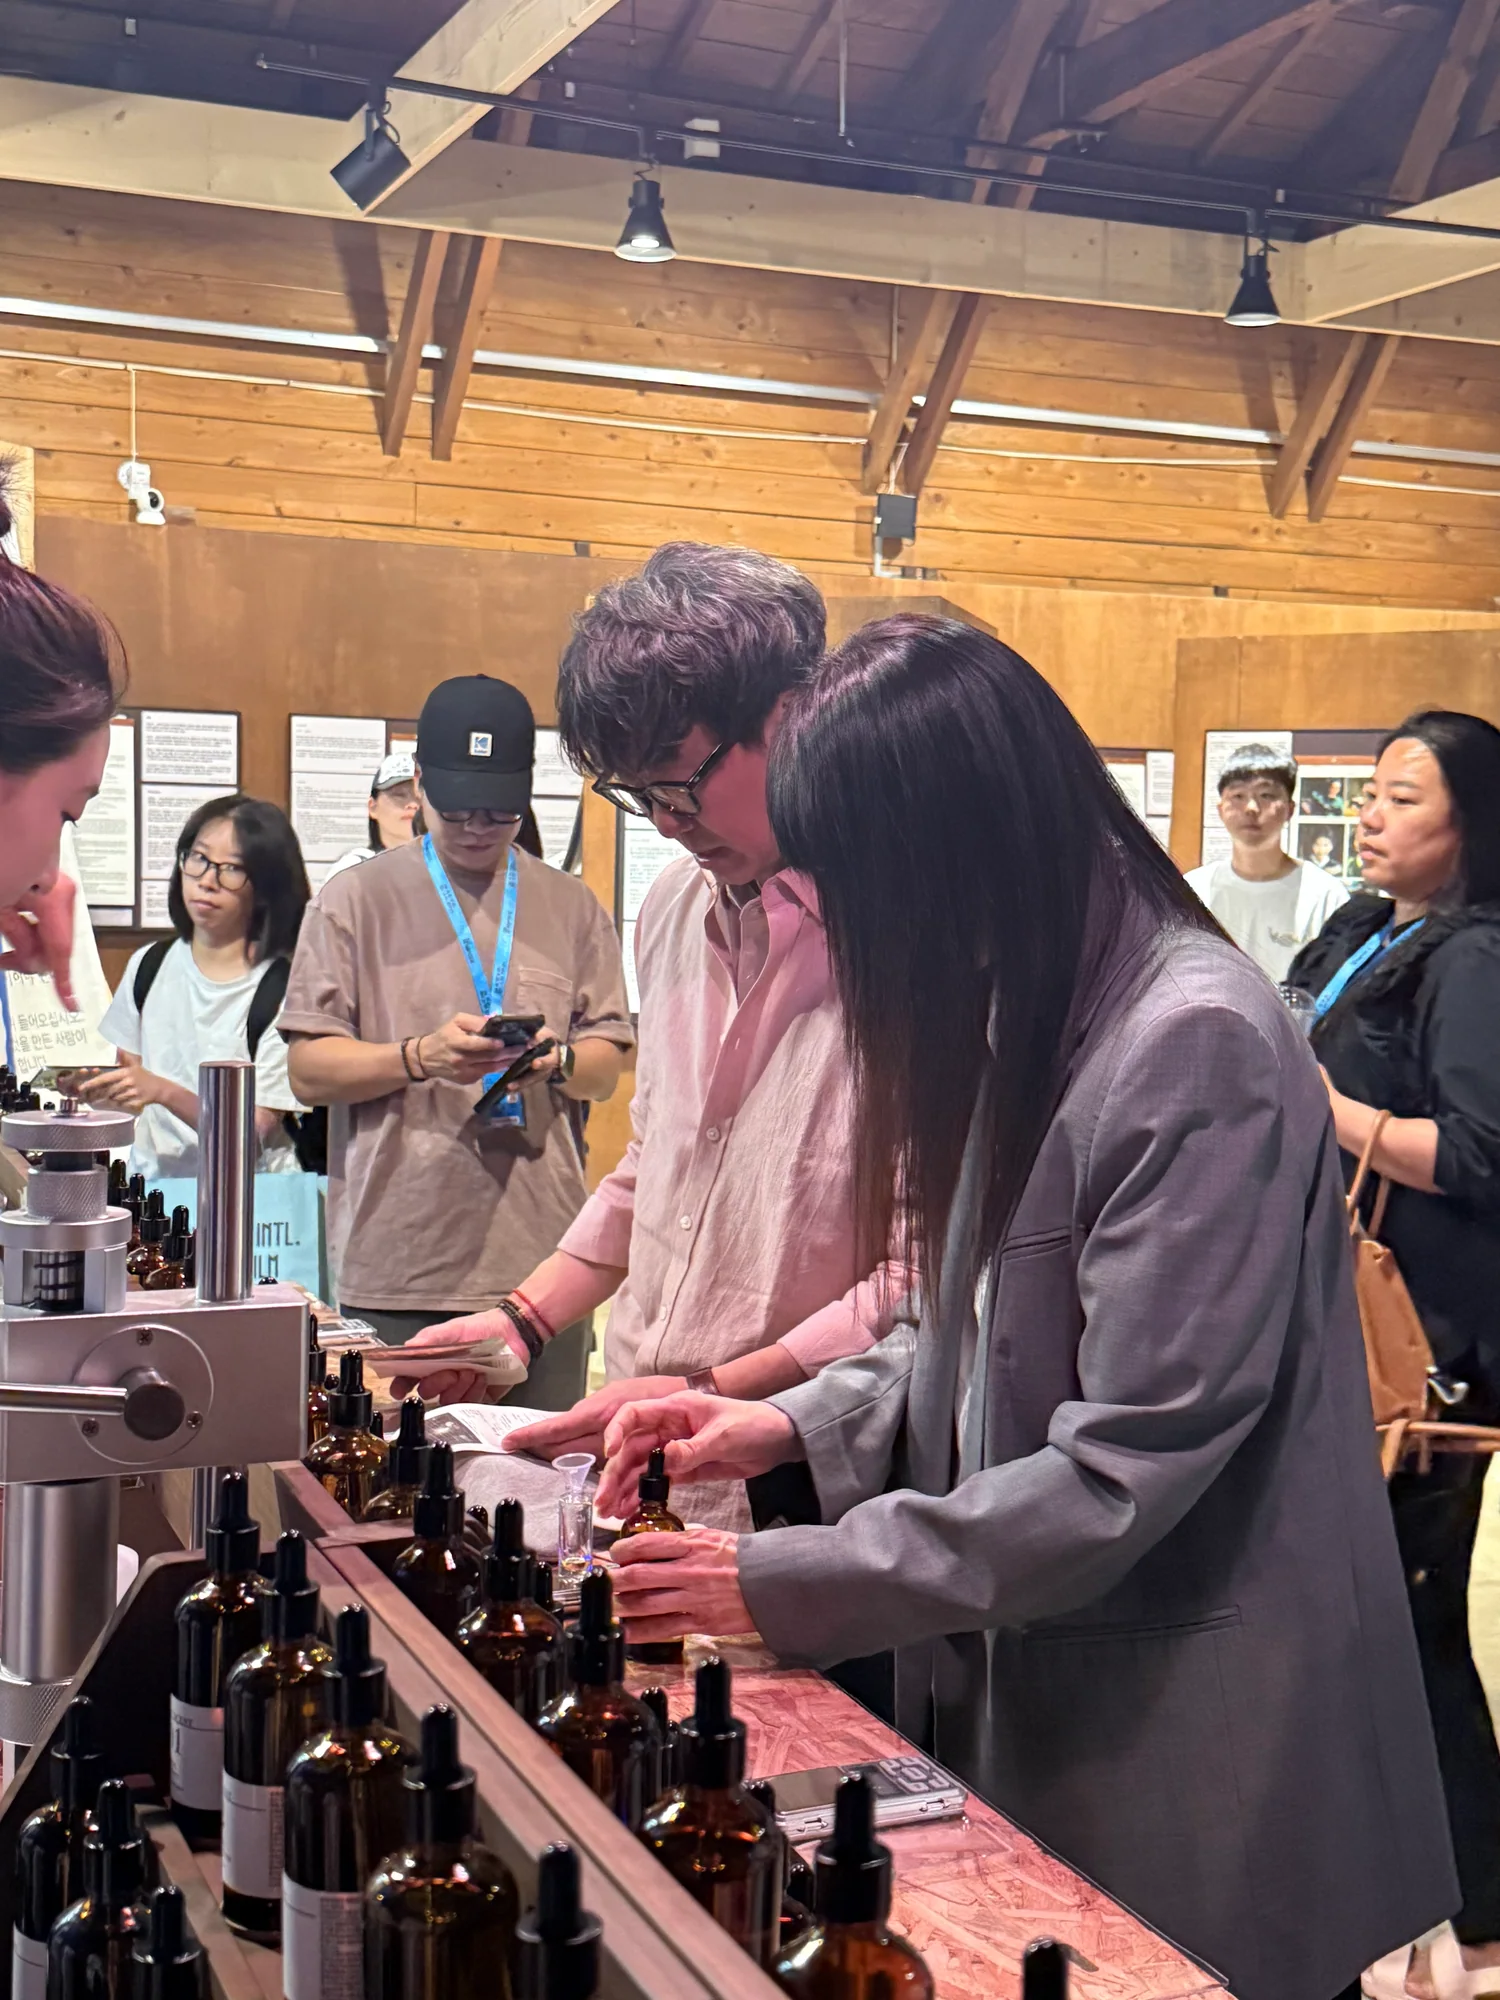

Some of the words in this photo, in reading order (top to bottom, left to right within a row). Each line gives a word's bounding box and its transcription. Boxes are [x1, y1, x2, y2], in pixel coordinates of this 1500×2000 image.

[56, 1028, 88, 1046] 사람이
[257, 1222, 300, 1247] INTL.
[254, 1254, 279, 1279] ILM
